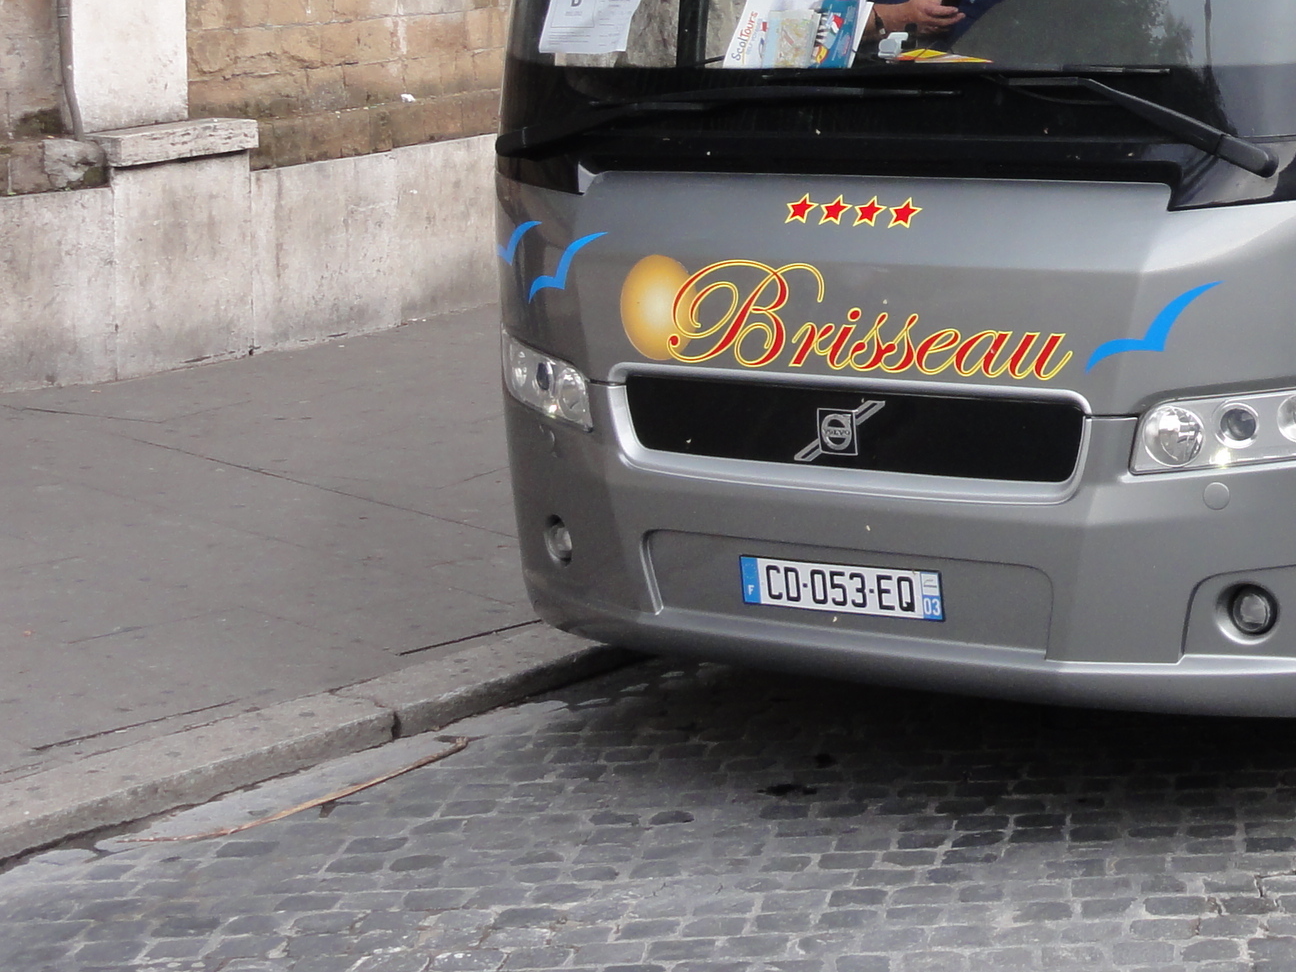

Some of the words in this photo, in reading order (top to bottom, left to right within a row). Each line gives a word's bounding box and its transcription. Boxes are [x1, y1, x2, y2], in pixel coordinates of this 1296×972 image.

[731, 11, 759, 61] ScolTours
[667, 259, 1073, 381] Brisseau
[824, 428, 851, 437] VOLVO
[748, 584, 755, 596] F
[765, 564, 916, 613] CD-053-EQ
[923, 598, 942, 617] 03
